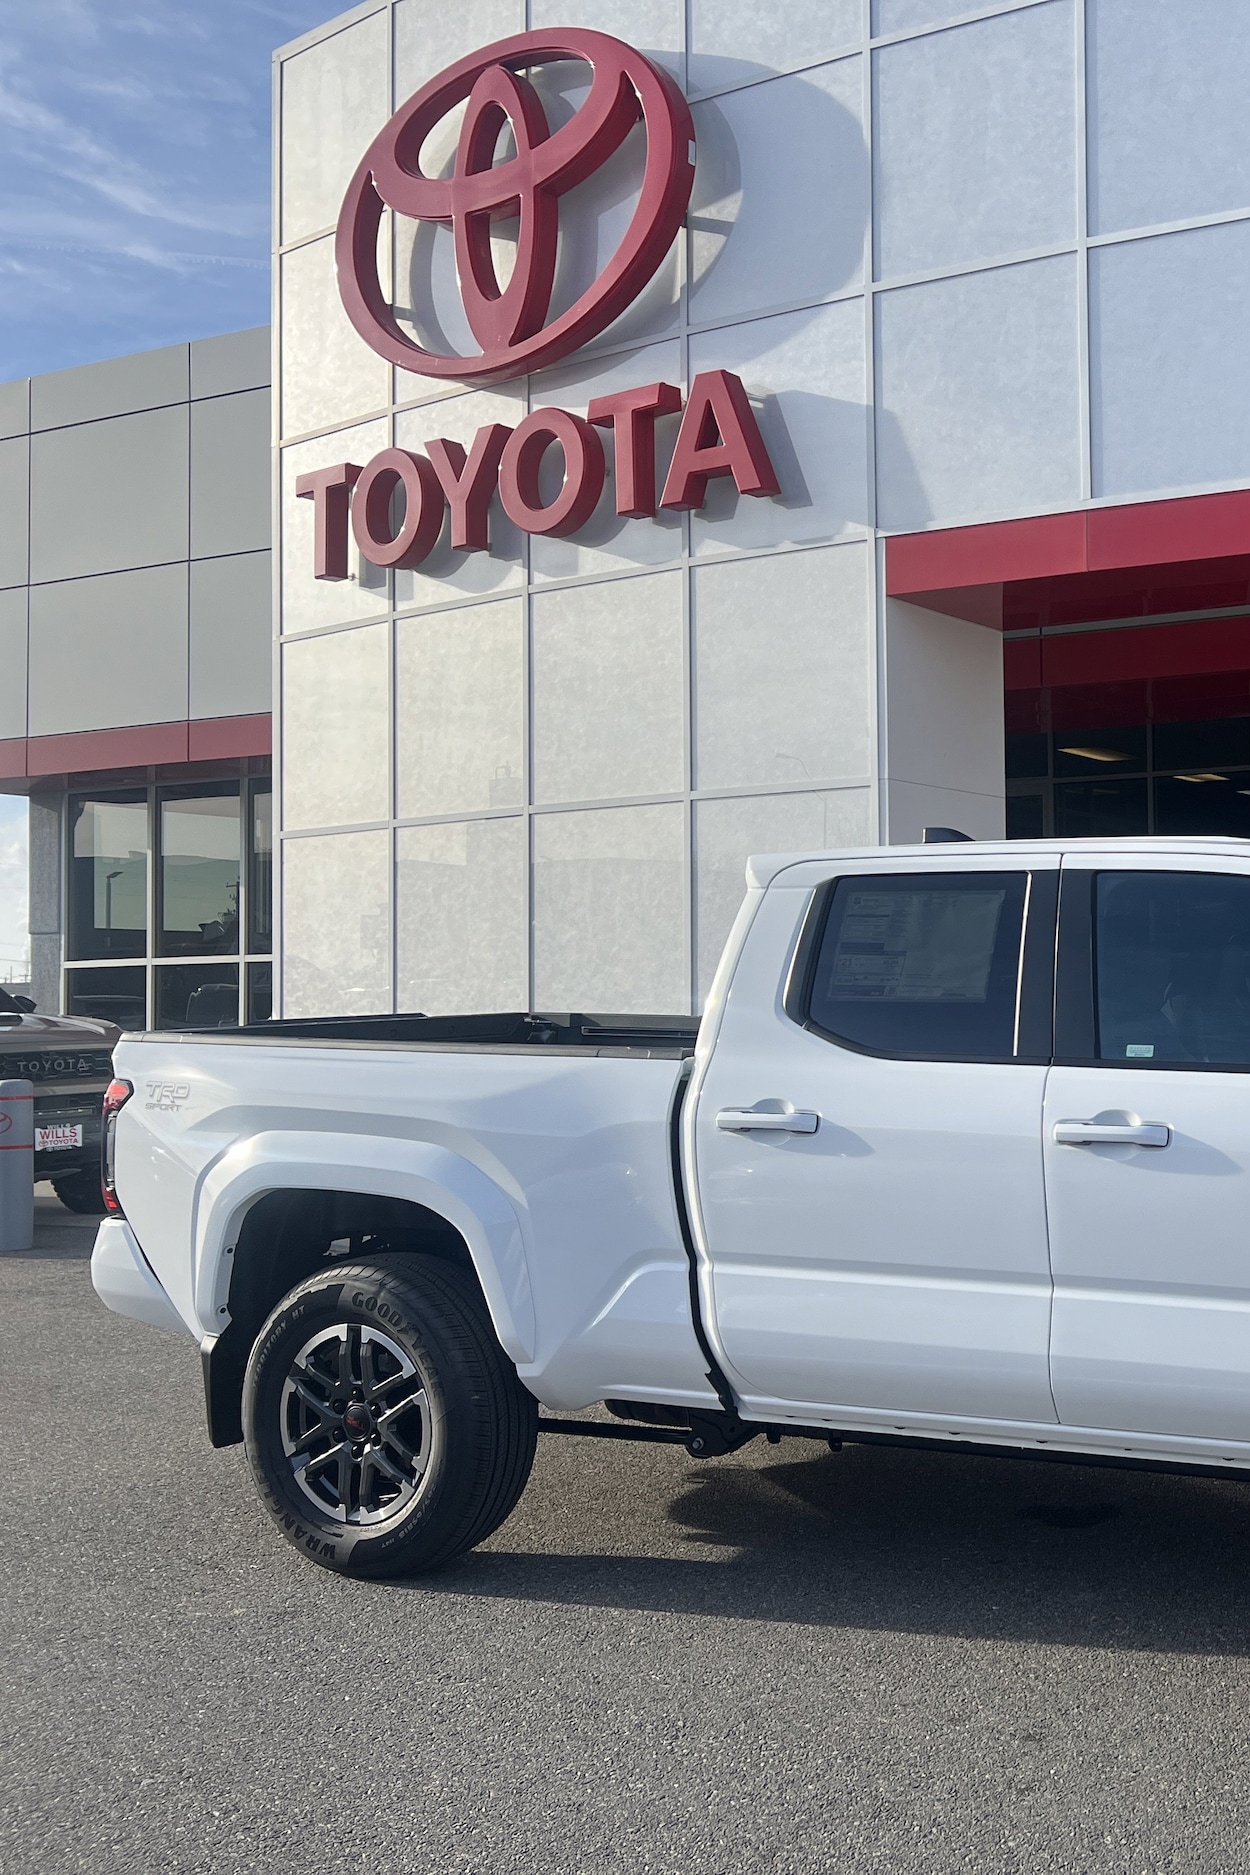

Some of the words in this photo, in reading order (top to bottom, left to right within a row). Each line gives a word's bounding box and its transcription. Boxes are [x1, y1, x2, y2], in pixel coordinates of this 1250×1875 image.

[296, 369, 781, 582] TOYOTA
[17, 1059, 87, 1073] TOYOTA
[145, 1080, 190, 1104] TRD
[145, 1102, 182, 1112] SPORT
[40, 1128, 77, 1139] WILLS
